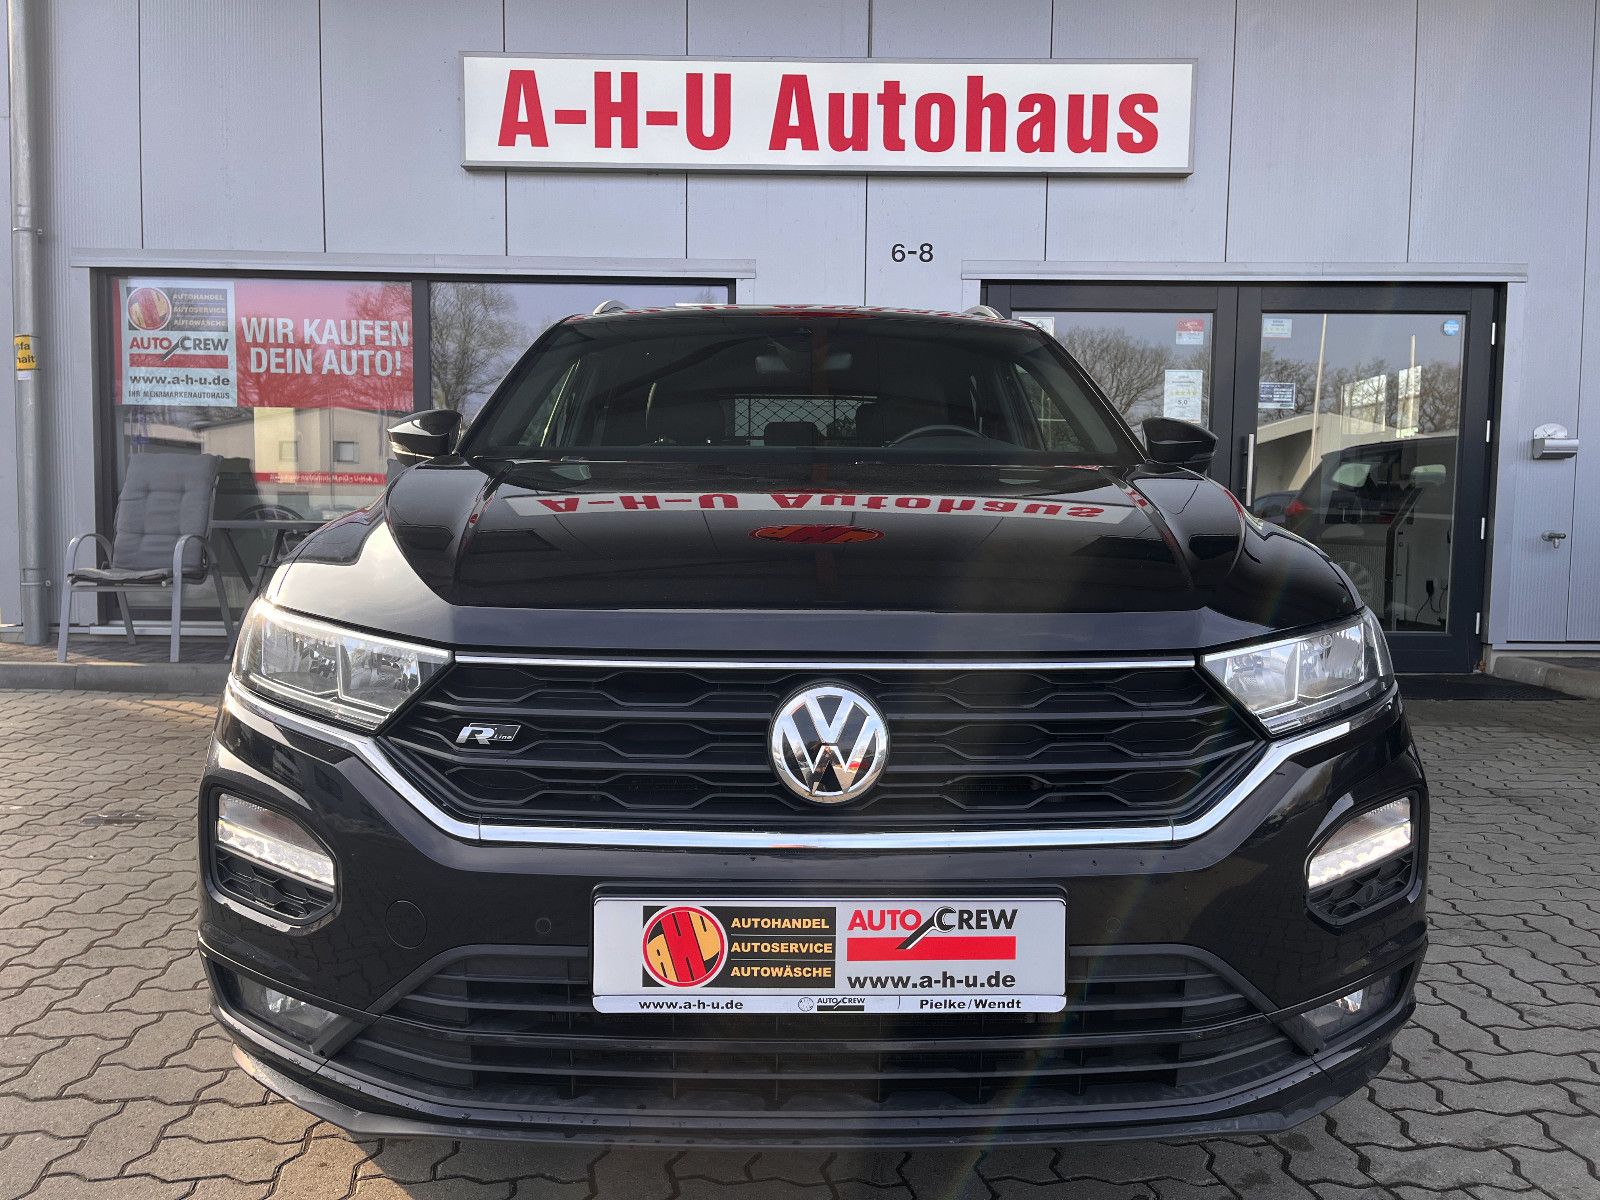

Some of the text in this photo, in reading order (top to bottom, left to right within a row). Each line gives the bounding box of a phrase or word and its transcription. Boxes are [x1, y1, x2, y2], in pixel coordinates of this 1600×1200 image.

[497, 69, 1159, 154] A-H-U Autohaus
[890, 242, 934, 263] 6-8
[172, 292, 225, 301] AUTOHANDEL
[241, 317, 409, 347] WIR KAUFEN
[129, 336, 229, 352] AUTO CREW
[250, 347, 402, 377] DEIN AUTO!
[129, 374, 231, 386] www.a-h-u.de
[143, 391, 230, 400] MEHRMARKENAUTOHAUS
[455, 726, 495, 745] R
[730, 917, 830, 929] AUTOHANDEL
[847, 907, 1019, 932] AUTO CREW
[730, 942, 833, 954] AUTOSERVICE
[730, 965, 832, 978] AUTOWÄSCHE
[846, 971, 1016, 988] www.a-h-u.de
[638, 999, 744, 1010] www.a-h-u.de
[919, 998, 1022, 1010] Pielke/Wendt
